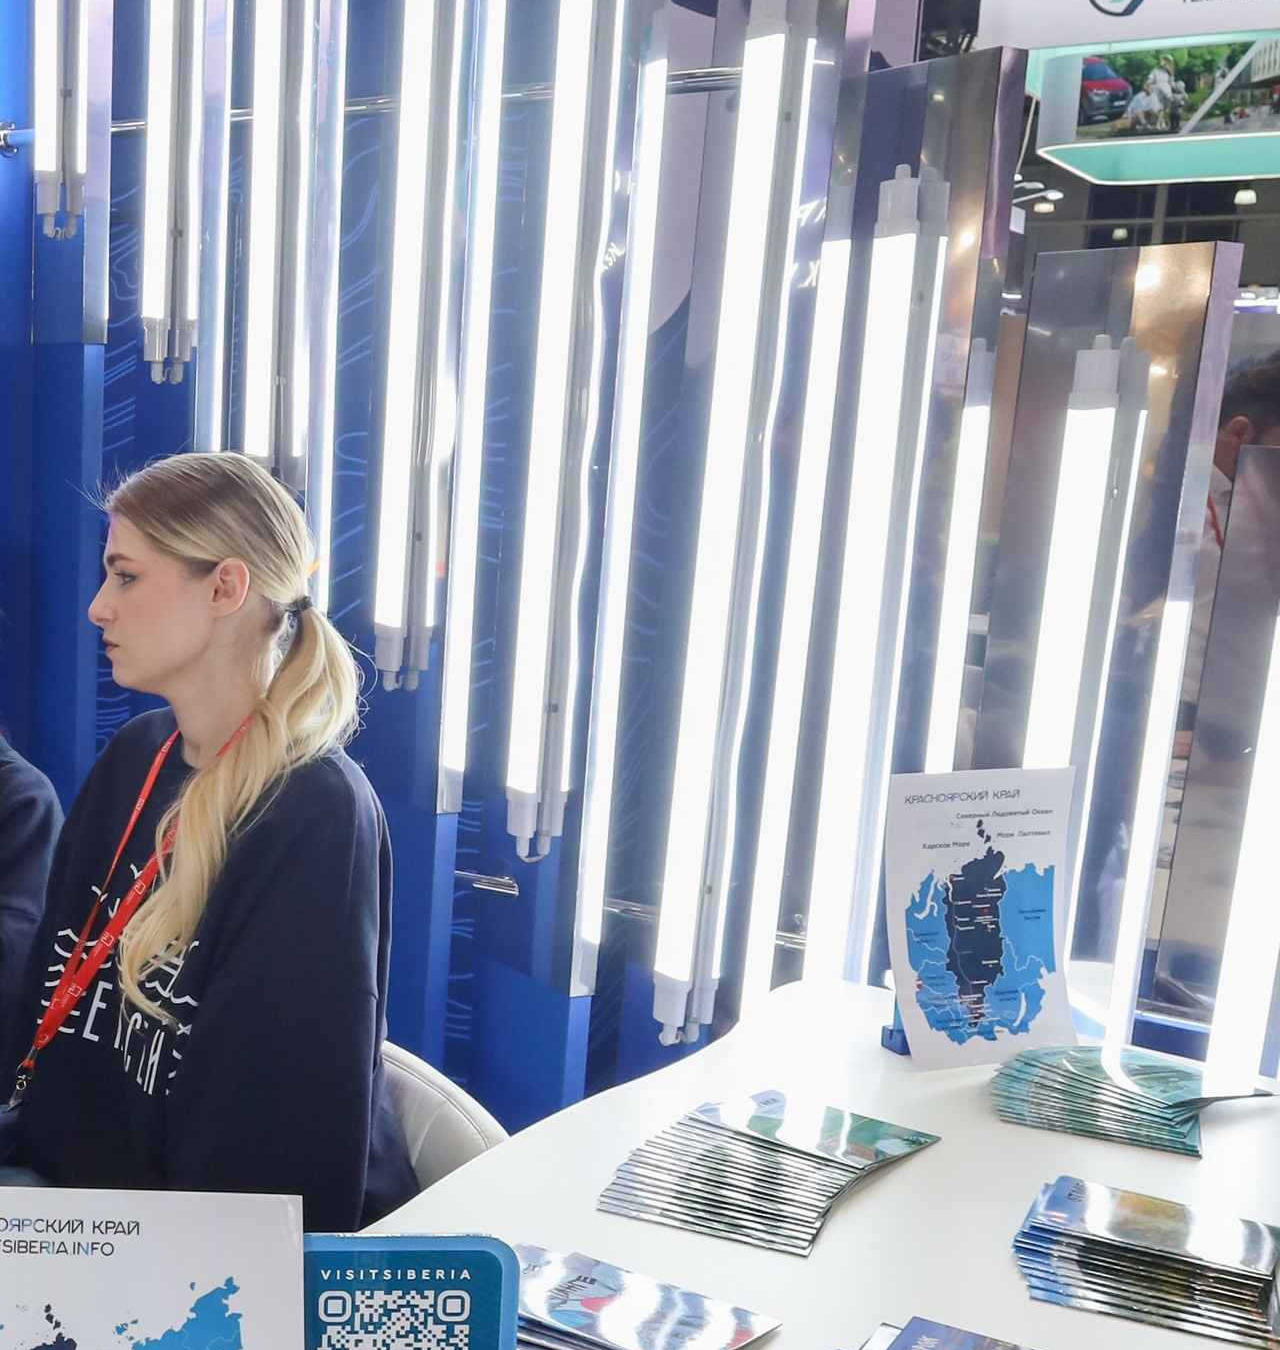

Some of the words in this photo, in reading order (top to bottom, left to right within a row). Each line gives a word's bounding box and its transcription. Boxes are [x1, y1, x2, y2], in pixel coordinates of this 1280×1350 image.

[904, 790, 988, 805] КРАСНОЯРСКИЙ
[993, 788, 1020, 800] КРАЙ
[92, 1219, 140, 1236] КРАЙ
[320, 1268, 471, 1280] VISITSIBERIA
